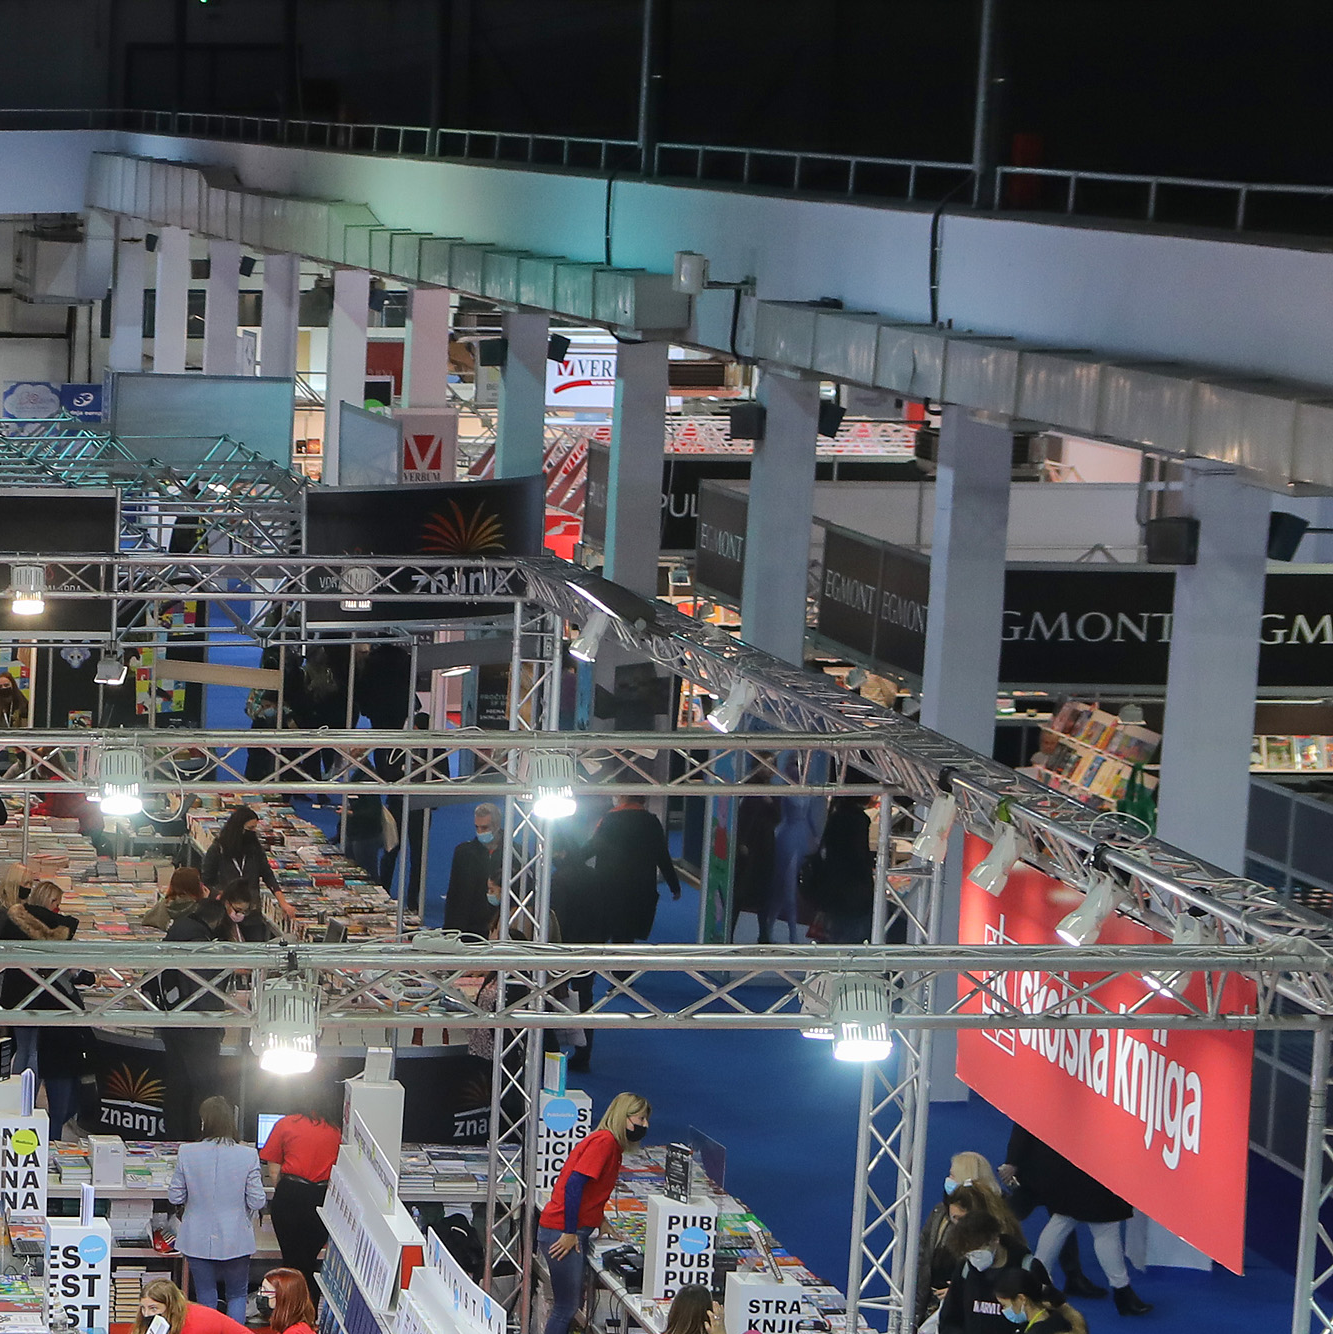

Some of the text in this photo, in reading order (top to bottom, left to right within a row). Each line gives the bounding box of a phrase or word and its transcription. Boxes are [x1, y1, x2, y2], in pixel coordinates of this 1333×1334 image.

[403, 471, 441, 482] VERBUM
[824, 568, 876, 615] EGMONT
[1113, 1002, 1203, 1171] knjiga
